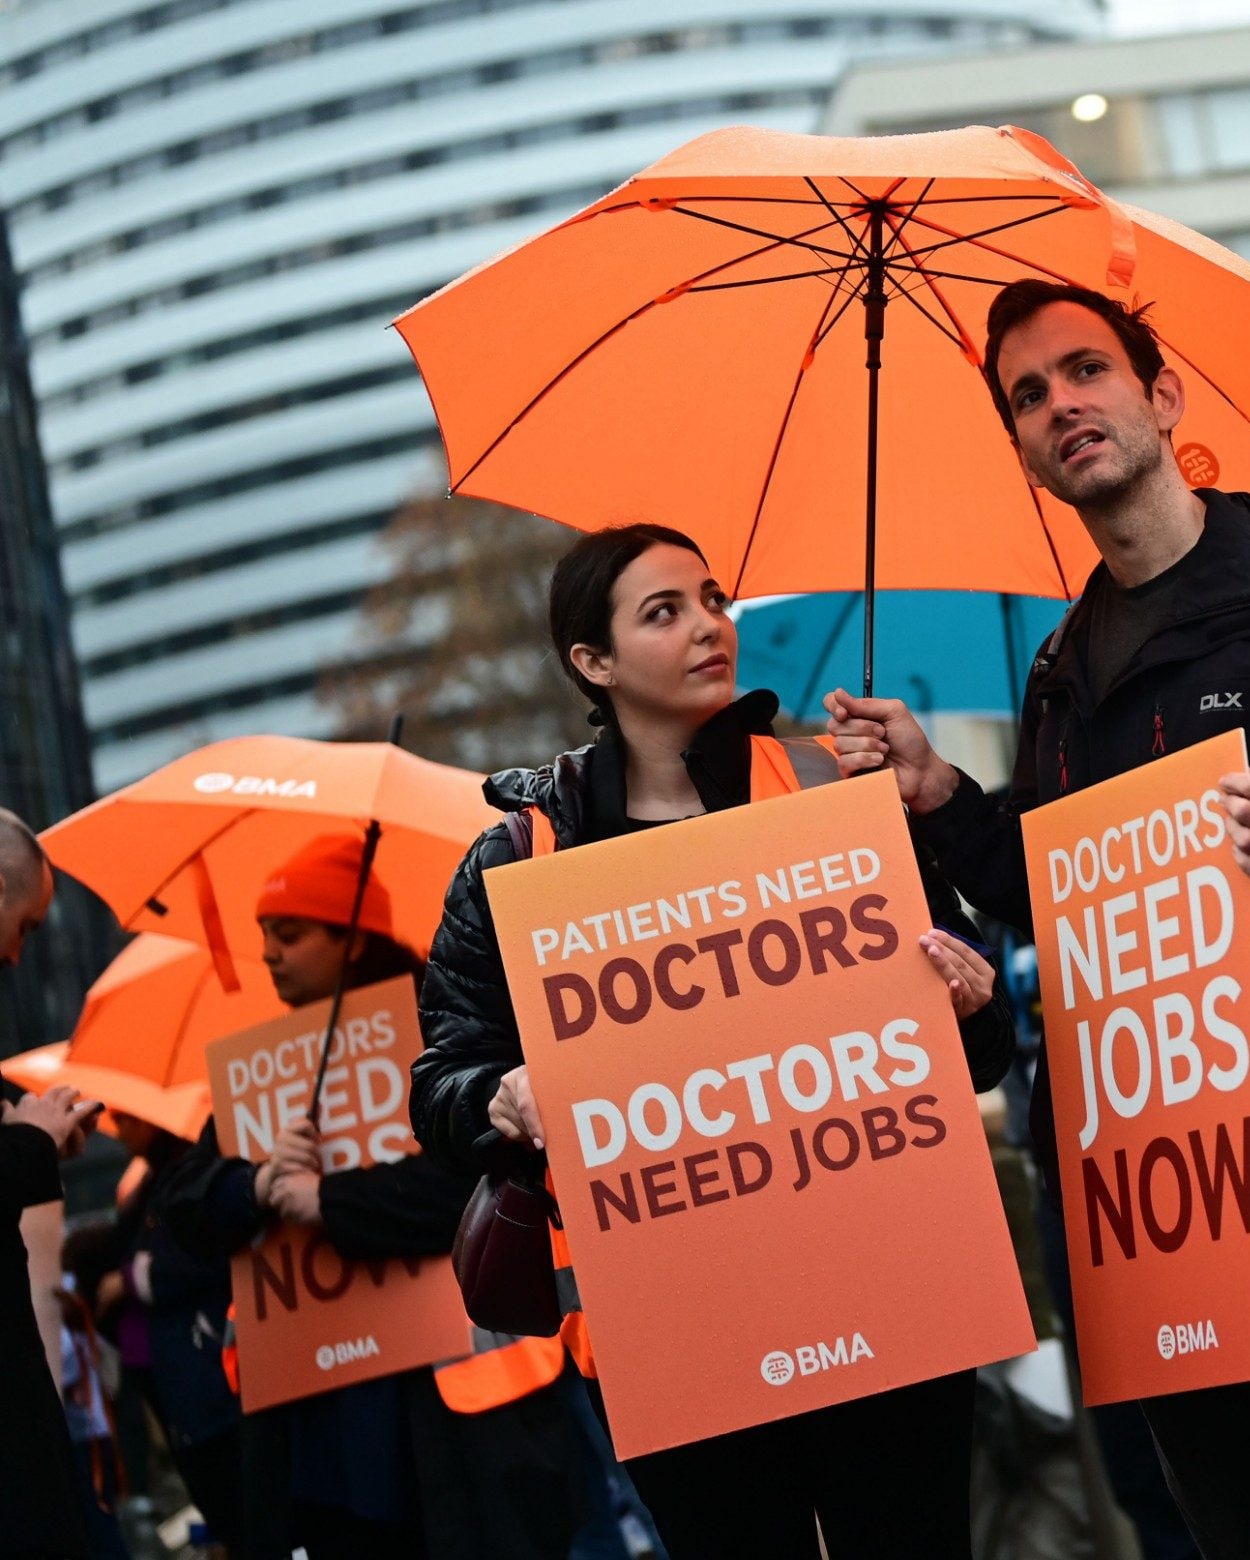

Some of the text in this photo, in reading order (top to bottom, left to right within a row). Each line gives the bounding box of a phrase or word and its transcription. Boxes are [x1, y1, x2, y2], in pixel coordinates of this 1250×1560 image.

[1200, 692, 1243, 710] DLX
[232, 775, 316, 798] BMA
[1048, 789, 1226, 904] DOCTORS
[531, 847, 882, 965] PATIENTS NEED
[1055, 865, 1234, 1010] NEED
[542, 893, 899, 1042] DOCTORS
[227, 1010, 396, 1098] DOCTORS
[571, 1018, 931, 1168] DOCTORS
[1077, 975, 1250, 1151] JOBS
[589, 1094, 947, 1231] NEED JOBS
[336, 1334, 379, 1365] BMA
[795, 1332, 874, 1377] BMA
[1176, 1320, 1219, 1356] BMA
